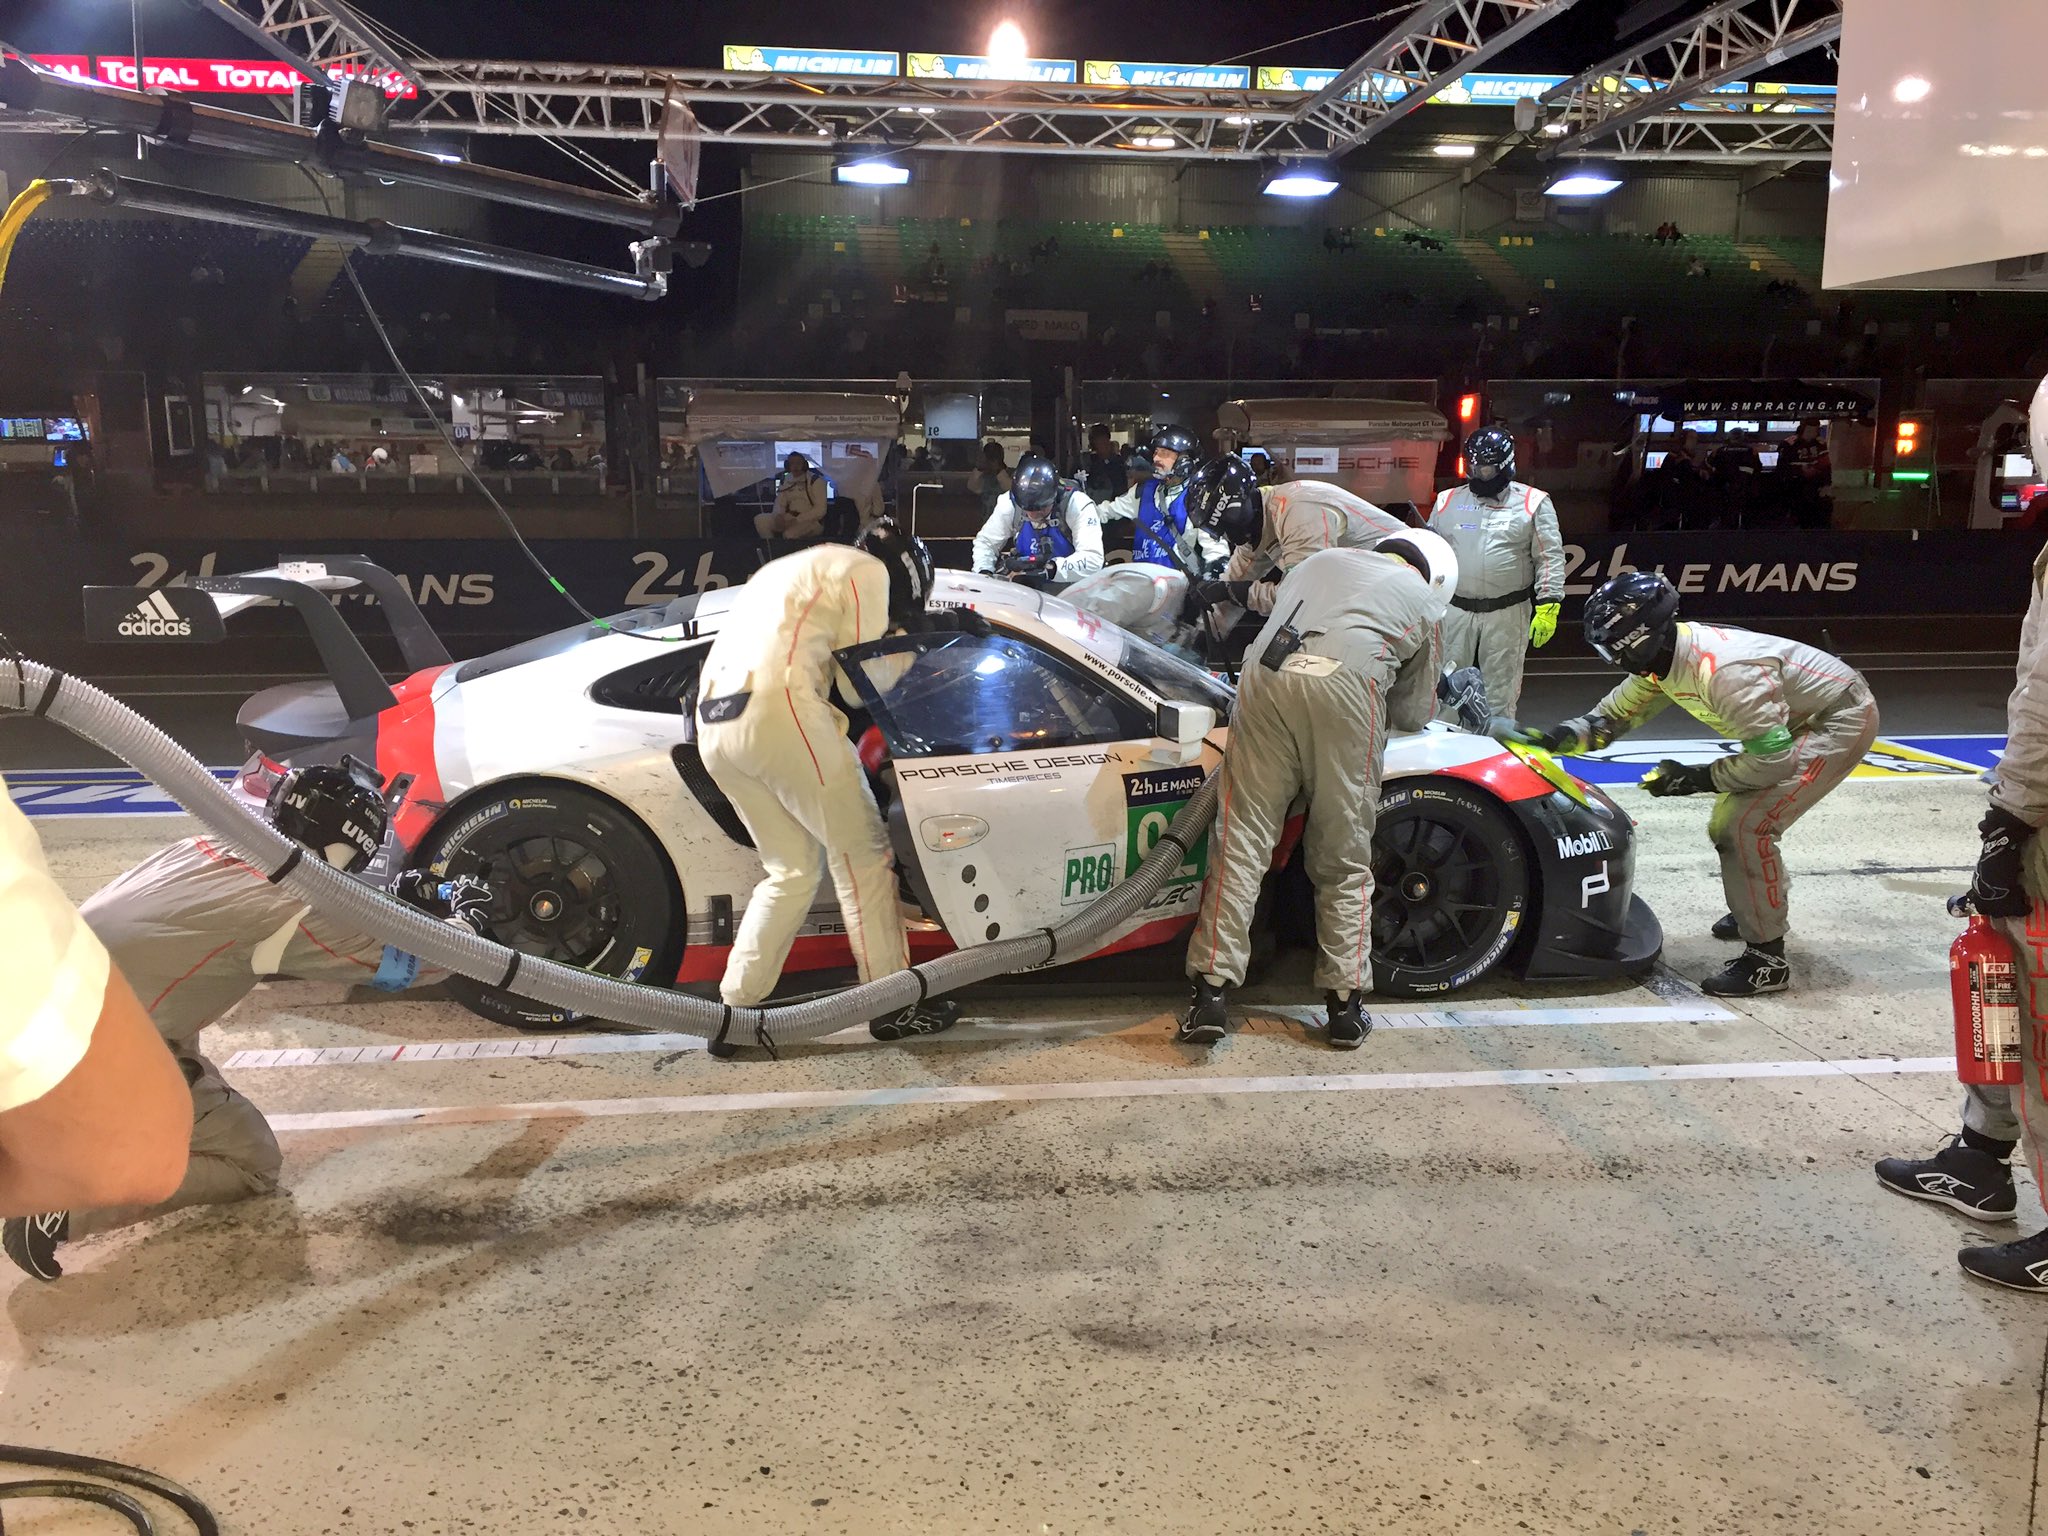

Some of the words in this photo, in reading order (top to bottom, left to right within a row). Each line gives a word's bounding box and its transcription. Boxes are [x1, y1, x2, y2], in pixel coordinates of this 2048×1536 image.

[101, 61, 199, 86] TOTAL
[210, 64, 303, 89] TOTAL
[774, 55, 893, 75] MICHELIN
[1131, 70, 1244, 88] MICHELIN
[1208, 492, 1232, 527] uvex
[1717, 562, 1858, 593] MANS
[118, 616, 191, 636] adidas
[1611, 622, 1650, 651] uvex
[900, 761, 1030, 782] PORSCHE
[1035, 752, 1123, 769] DESIGN
[986, 772, 1062, 785] TIMEPIECES
[1130, 778, 1154, 797] 24h
[1155, 781, 1169, 793] LE
[1170, 777, 1202, 792] MANS
[1376, 792, 1407, 813] ELIN
[364, 807, 381, 828] uvex
[440, 803, 502, 859] MICHELIN
[341, 819, 379, 858] uvex
[1557, 831, 1602, 860] Mobil
[1600, 832, 1610, 849] 1
[1064, 852, 1113, 898] PRO
[1455, 934, 1509, 986] MICHELIN
[1987, 964, 2006, 972] FEV
[1971, 990, 1984, 1059] FESG2000RHH
